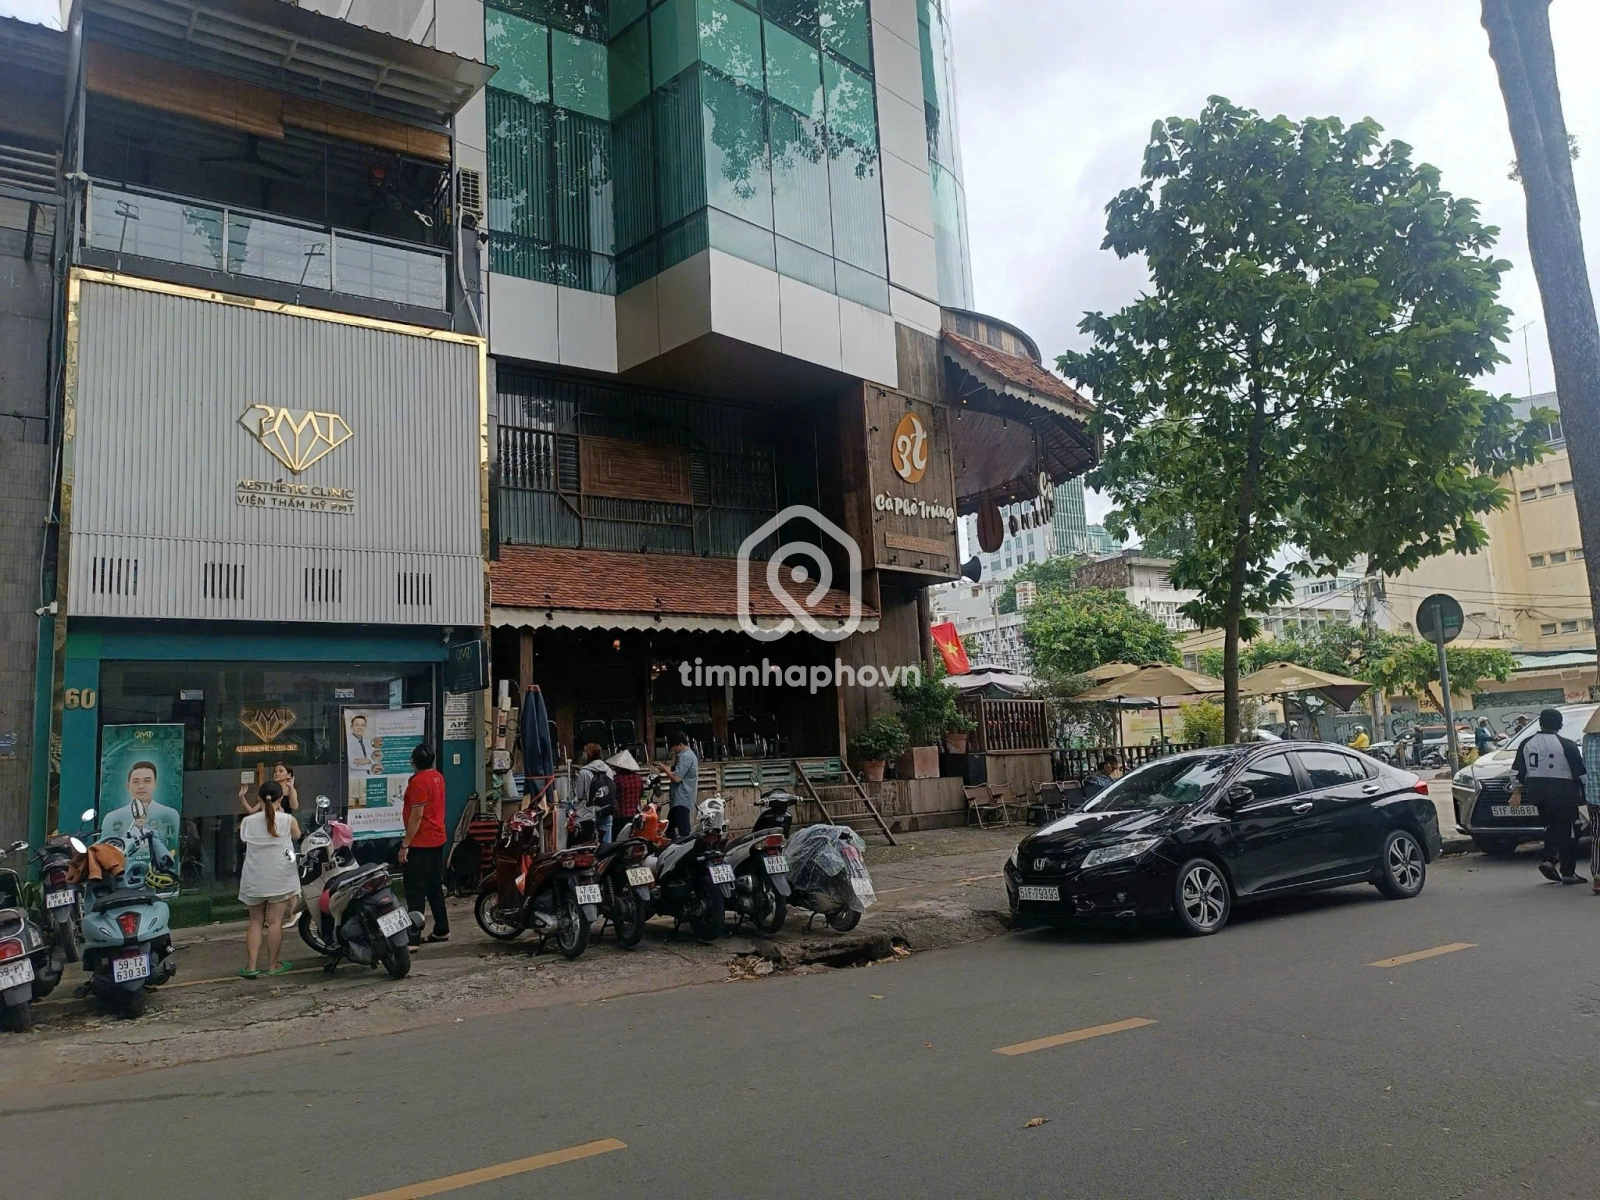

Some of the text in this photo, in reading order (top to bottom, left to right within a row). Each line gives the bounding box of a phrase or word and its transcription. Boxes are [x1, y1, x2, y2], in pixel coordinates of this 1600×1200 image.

[311, 486, 355, 499] CLINIC
[875, 490, 894, 511] Cà
[237, 494, 266, 506] VIỆN
[331, 502, 355, 512] PMT
[65, 688, 96, 709] 60
[118, 957, 144, 970] 59-T2
[117, 967, 147, 981] 630.38
